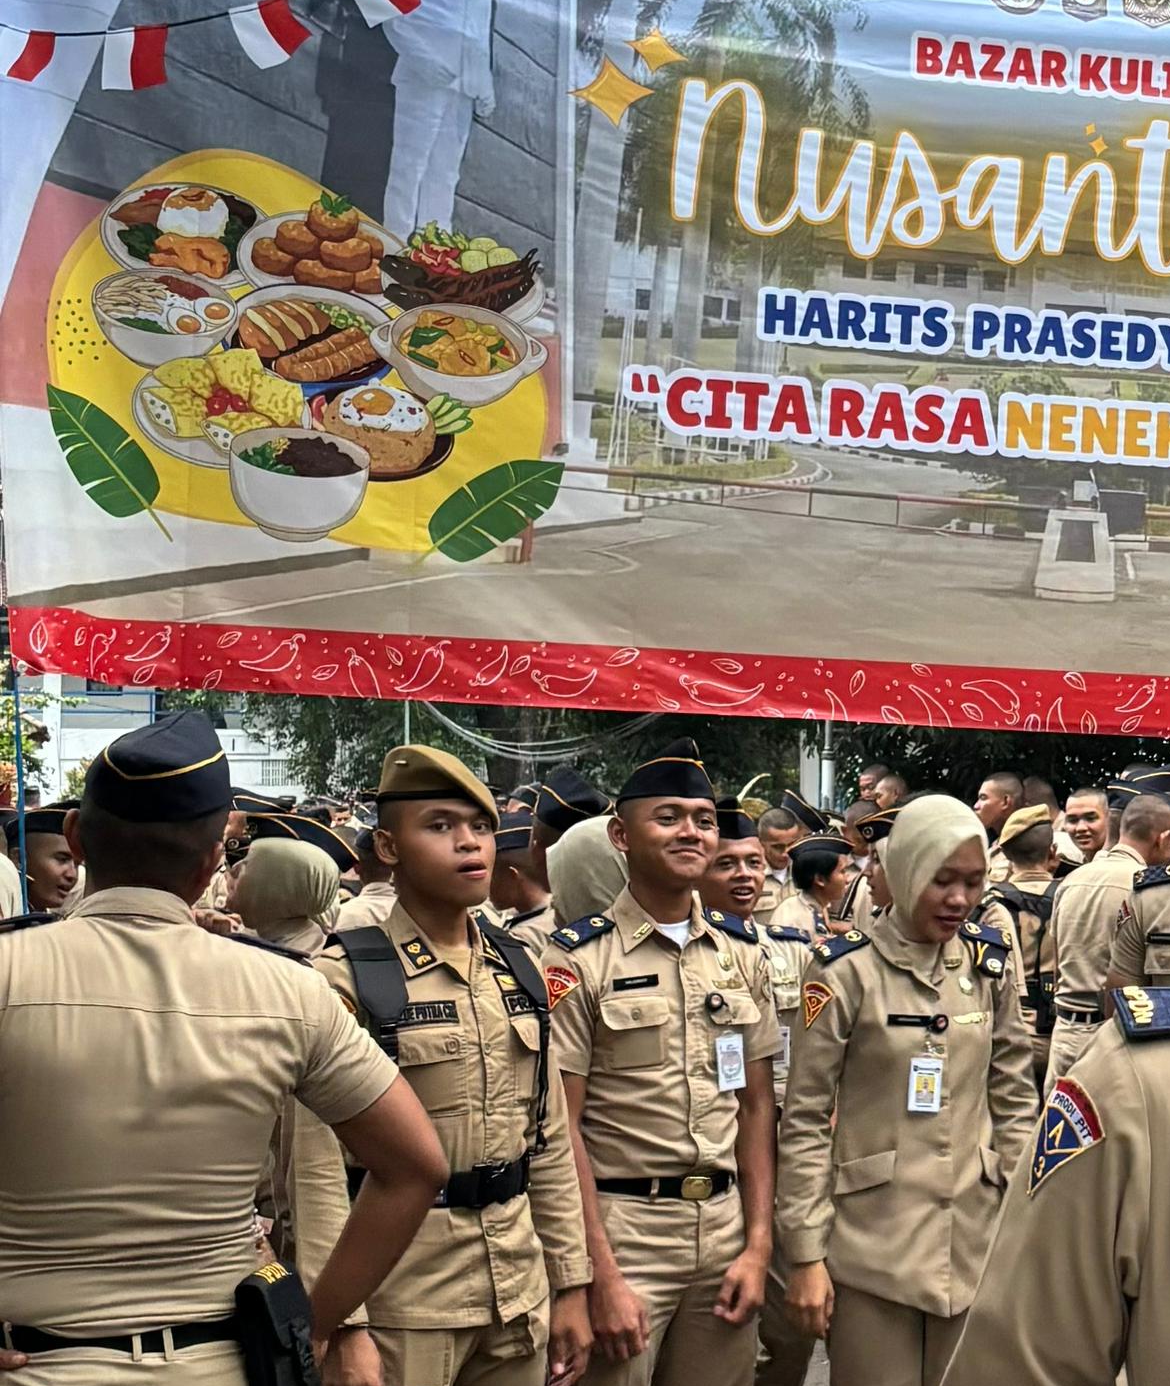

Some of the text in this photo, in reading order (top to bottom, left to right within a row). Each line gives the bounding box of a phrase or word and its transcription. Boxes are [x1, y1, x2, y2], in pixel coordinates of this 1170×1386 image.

[917, 39, 1067, 83] BAZAR
[763, 293, 948, 348] HARITS
[631, 372, 812, 434] "CITA
[828, 388, 988, 446] RASA
[1052, 1093, 1077, 1117] PRODI
